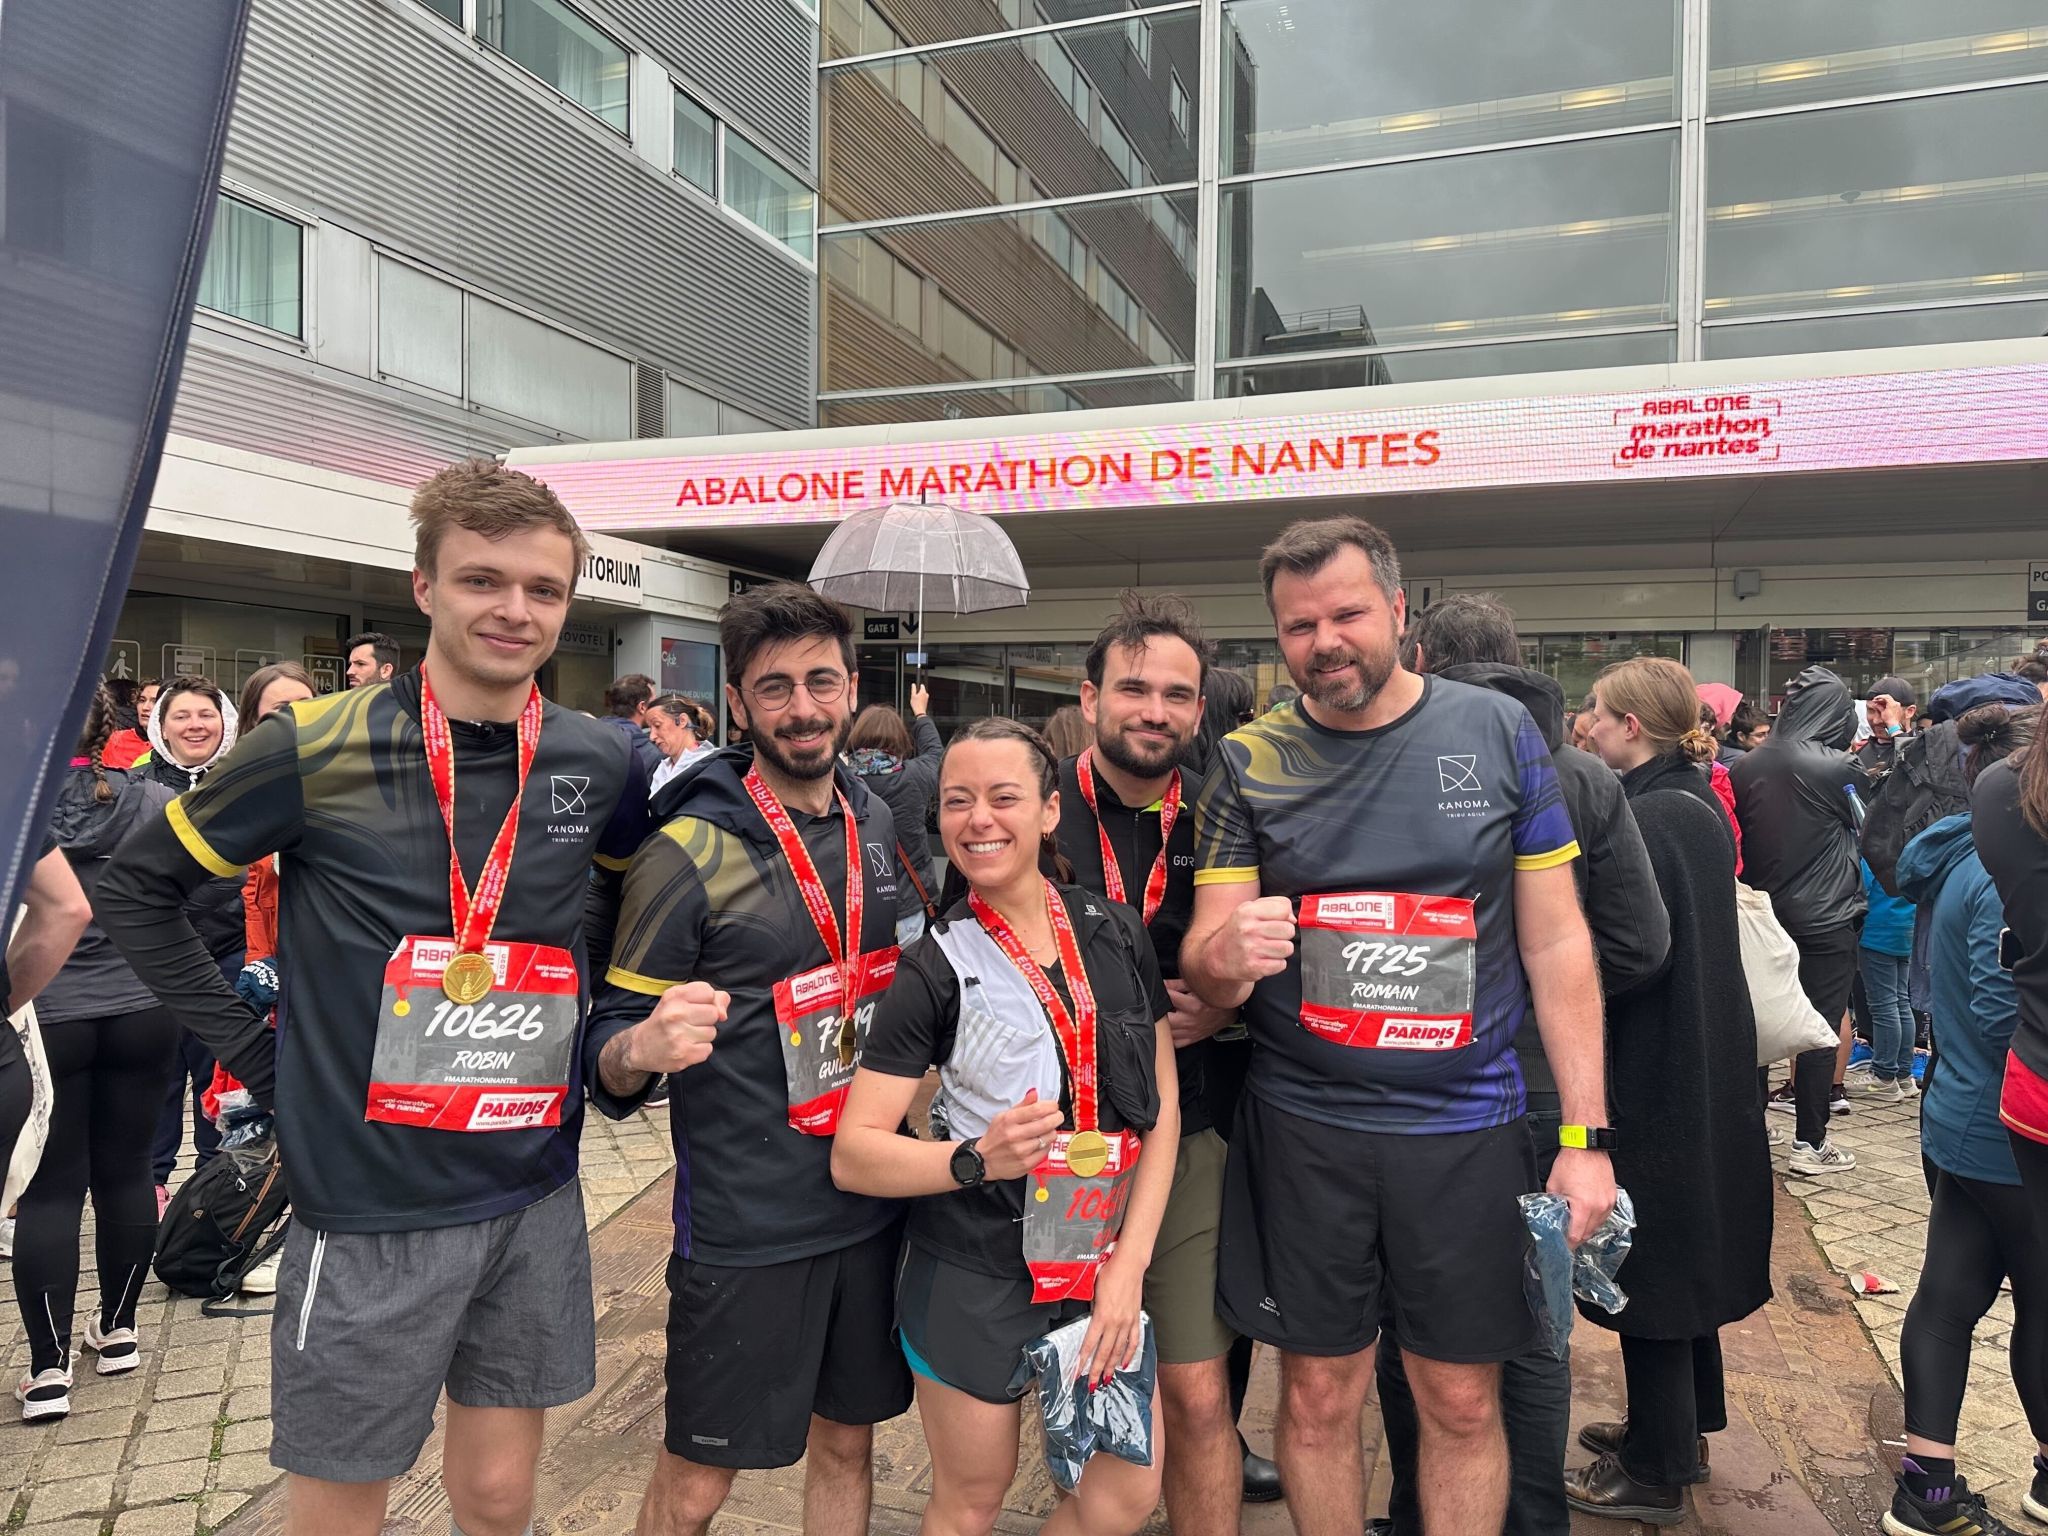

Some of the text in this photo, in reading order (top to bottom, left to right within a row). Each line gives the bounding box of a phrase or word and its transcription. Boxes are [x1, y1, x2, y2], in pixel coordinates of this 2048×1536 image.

[1643, 395, 1751, 416] ABALONE
[1630, 414, 1771, 440] marathon
[1620, 438, 1760, 460] de nantes
[676, 430, 1441, 507] ABALONE MARATHON DE NANTES
[867, 623, 896, 633] GATE 1
[751, 779, 780, 814] AVRIL
[1438, 800, 1491, 811] KANOMA
[547, 824, 590, 834] KANOMA
[773, 816, 791, 832] 23
[1321, 901, 1383, 913] ABALONE
[1055, 916, 1069, 931] 23
[1341, 941, 1431, 977] 9725
[795, 971, 840, 996] ABALONE
[1350, 982, 1420, 1001] ROMAIN
[1352, 1002, 1419, 1013] #MARATHONNANTES
[424, 1001, 544, 1041] 10626
[1384, 1025, 1456, 1040] PARIDIS
[451, 1050, 516, 1071] ROBIN
[443, 1075, 518, 1085] #MARATHONNANTES
[477, 1099, 549, 1118] PARIDIS
